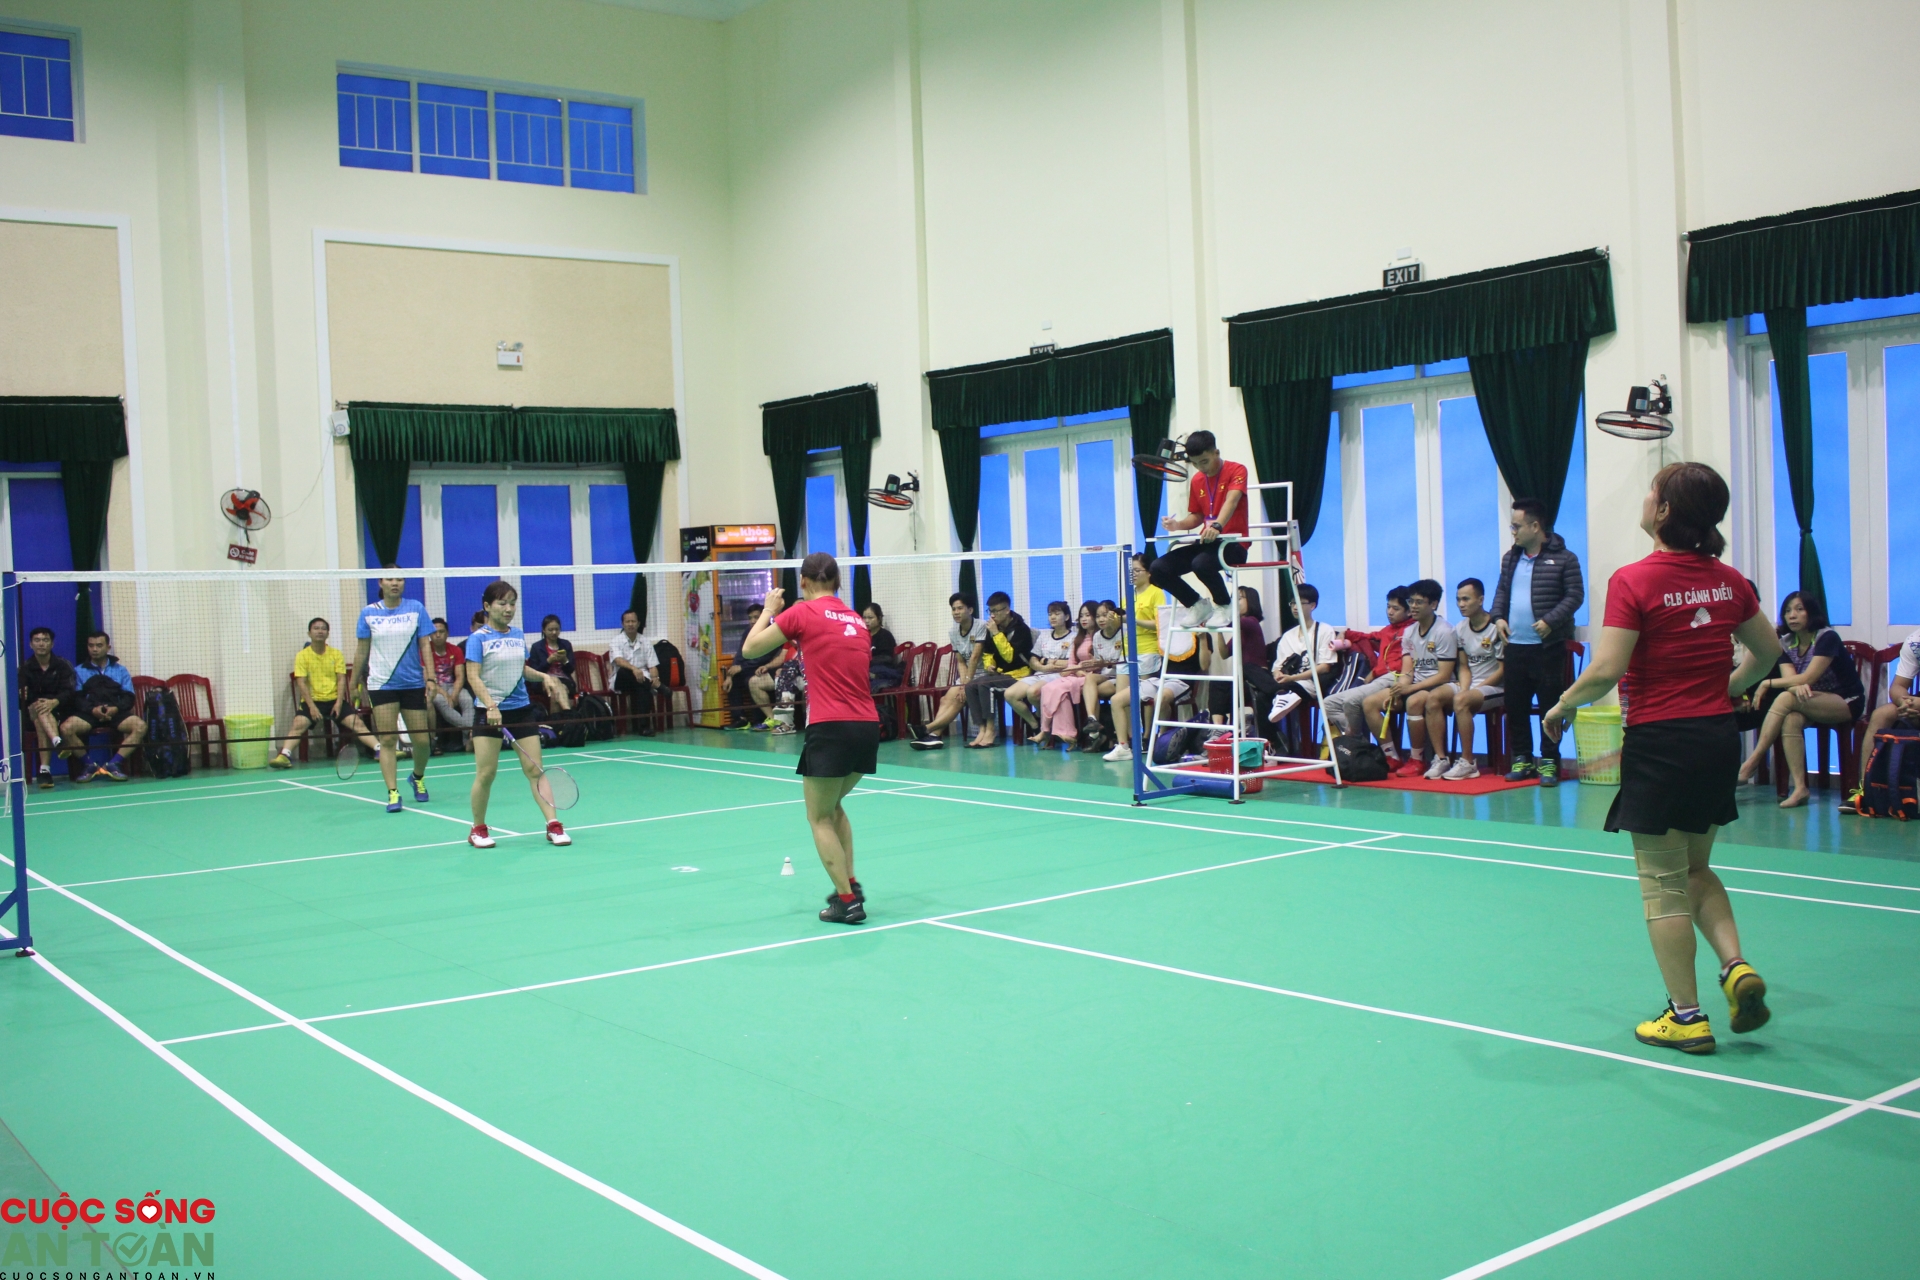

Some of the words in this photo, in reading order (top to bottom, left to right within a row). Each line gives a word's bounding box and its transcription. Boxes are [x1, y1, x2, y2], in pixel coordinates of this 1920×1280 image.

[1387, 266, 1417, 285] EXIT
[1663, 592, 1683, 607] CLB
[1684, 587, 1711, 604] CÁNH
[387, 616, 412, 624] YONEX
[824, 609, 838, 620] CLB
[838, 612, 856, 624] CÁNH
[504, 639, 525, 648] YONE
